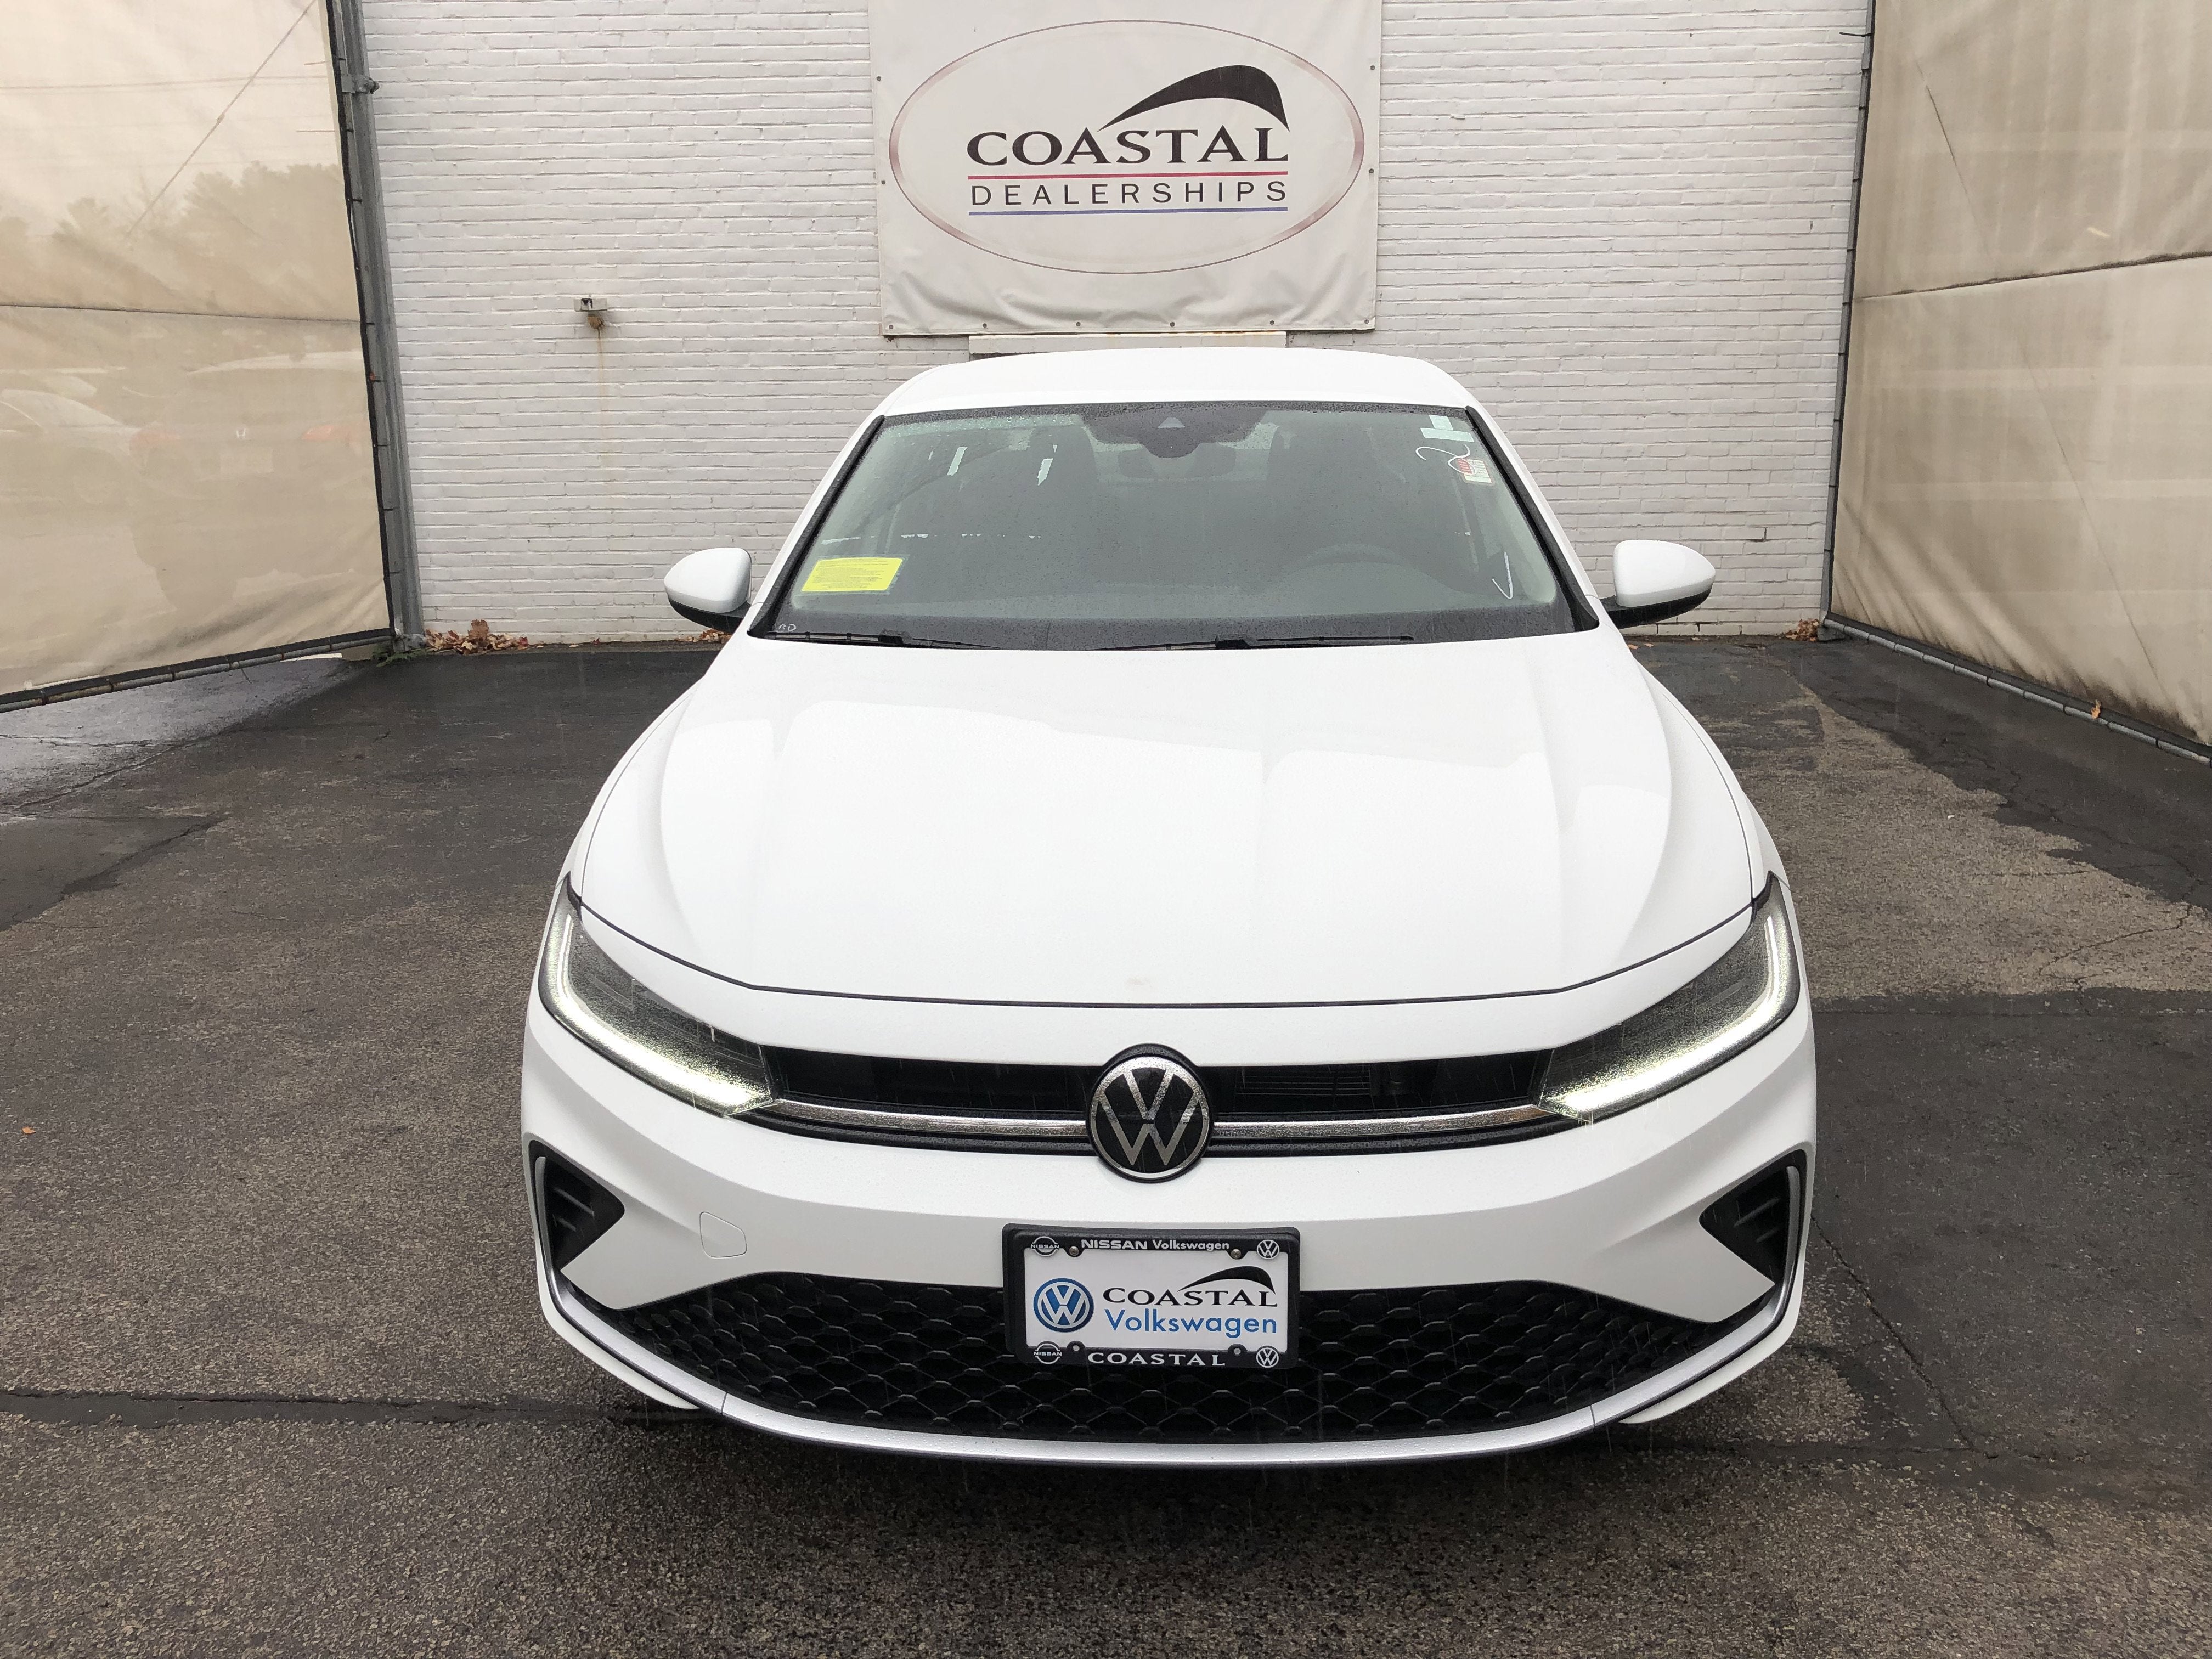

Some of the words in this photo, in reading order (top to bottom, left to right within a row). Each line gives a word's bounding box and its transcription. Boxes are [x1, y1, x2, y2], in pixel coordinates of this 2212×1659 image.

[967, 125, 1289, 166] COASTAL
[972, 181, 1286, 206] DEALERSHIPS
[1081, 1239, 1148, 1250] NISSAN
[1152, 1239, 1229, 1251] Volkswagen
[1103, 1287, 1278, 1307] COASTAL
[1104, 1308, 1277, 1338] Volkswagen
[1087, 1352, 1226, 1366] COASTAL
